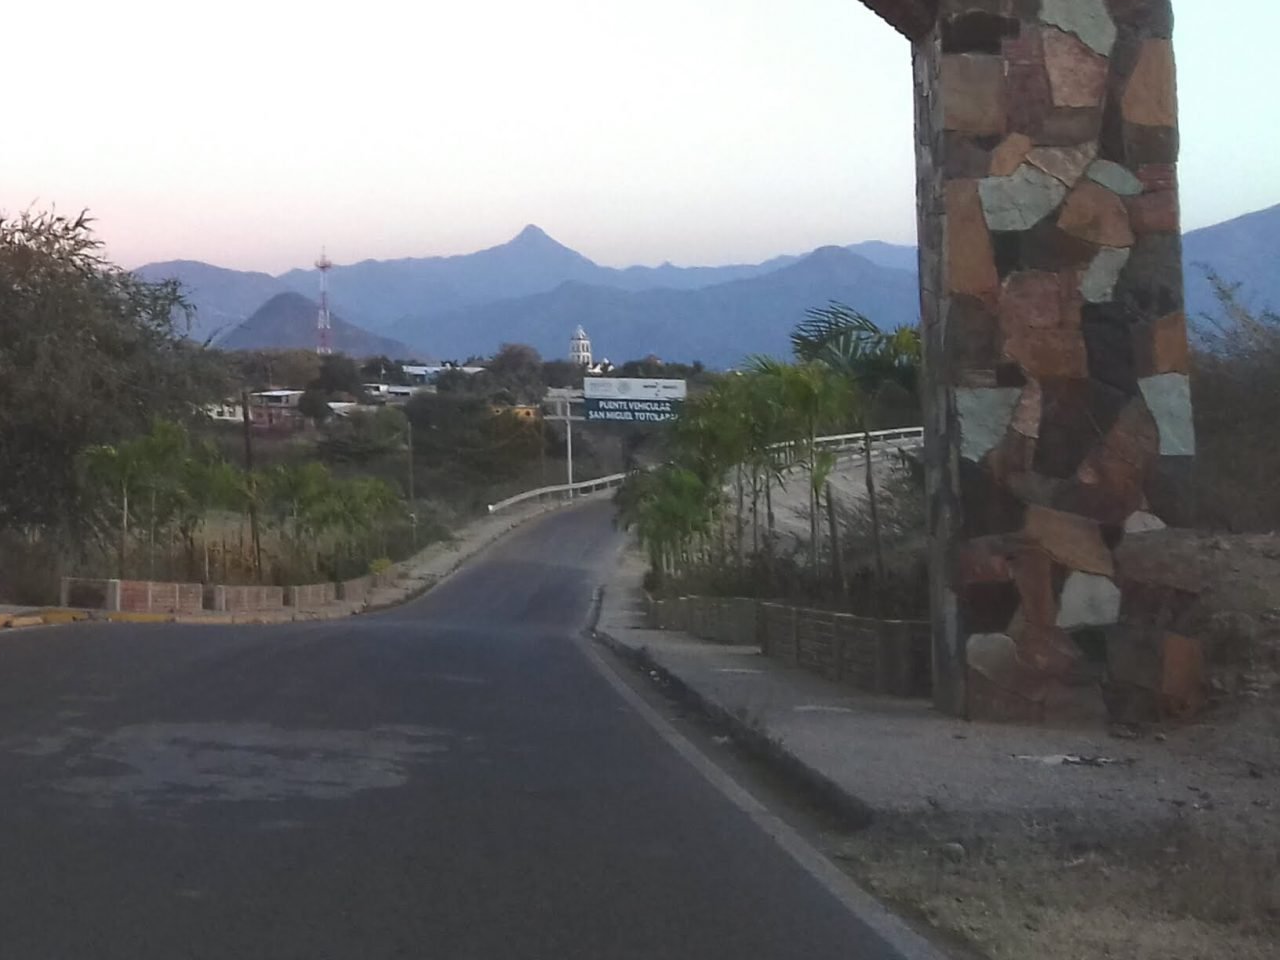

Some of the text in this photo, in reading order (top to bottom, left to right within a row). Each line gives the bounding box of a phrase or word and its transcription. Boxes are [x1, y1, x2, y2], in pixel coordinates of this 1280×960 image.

[599, 400, 672, 412] PUENTE VEHICULAR
[588, 410, 605, 419] SAN
[606, 411, 633, 420] MIGUEL
